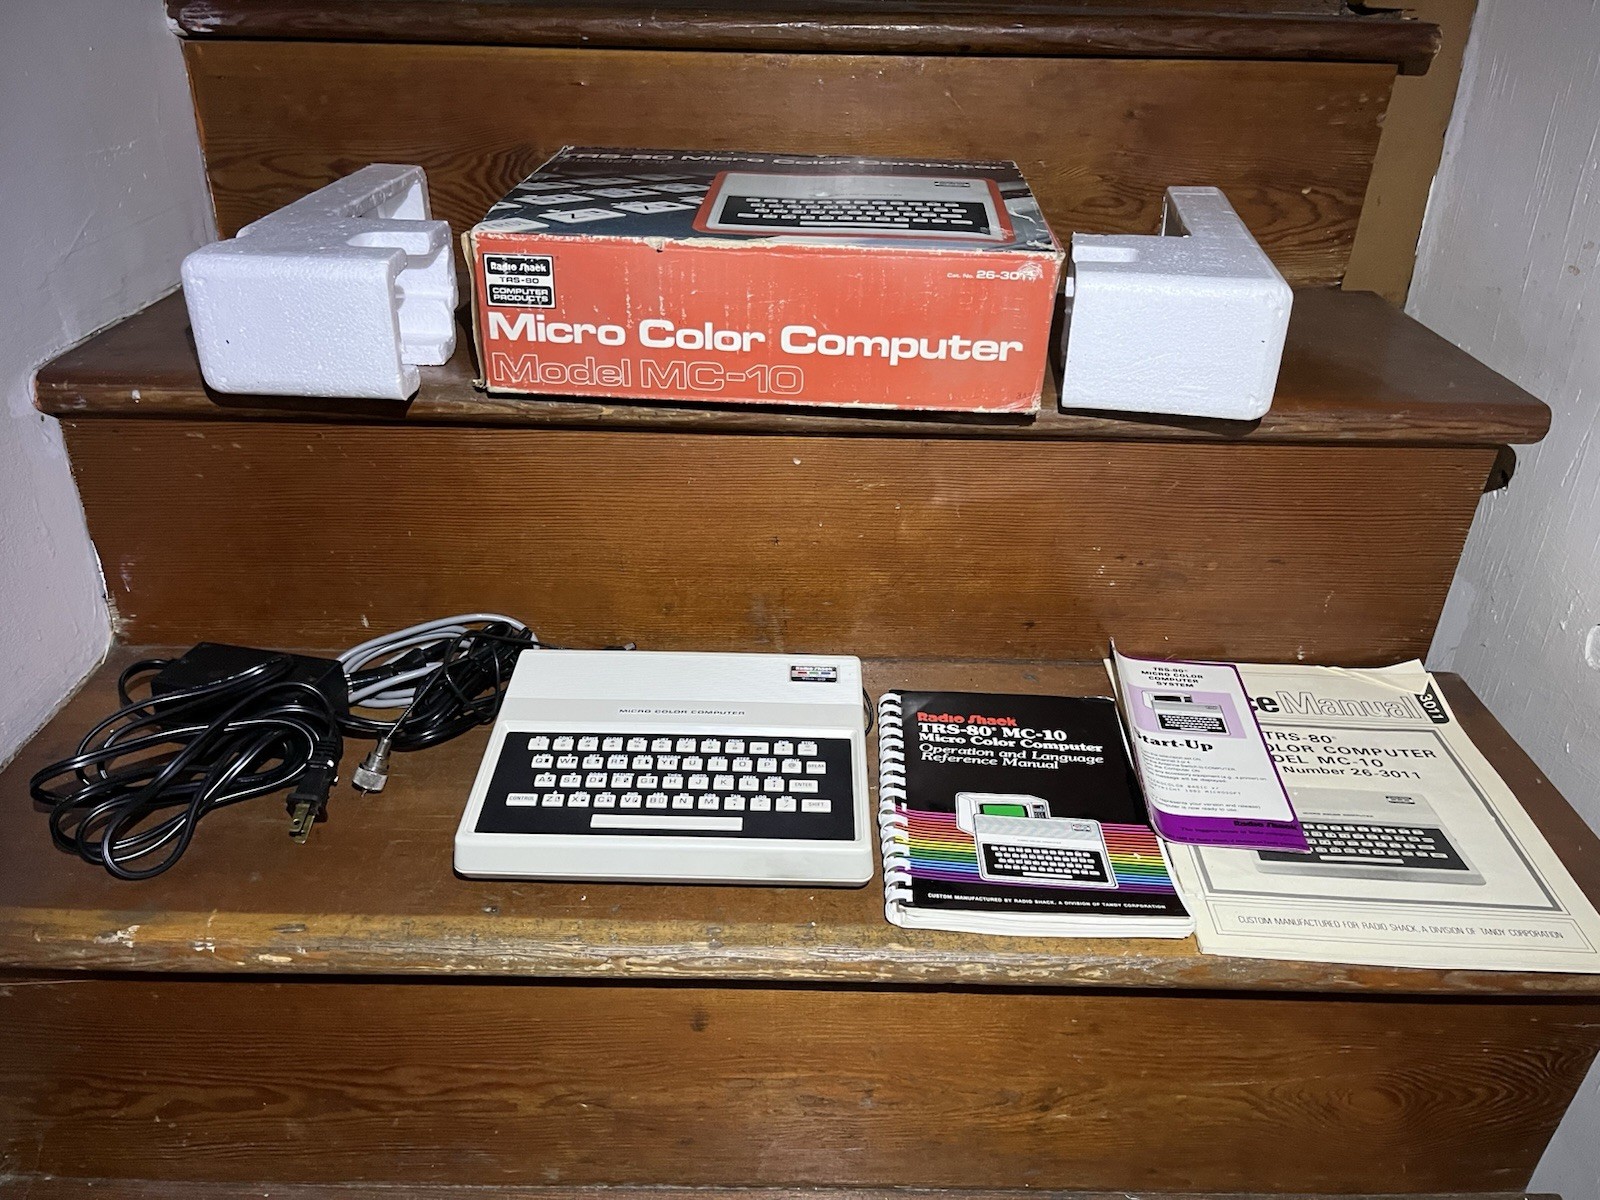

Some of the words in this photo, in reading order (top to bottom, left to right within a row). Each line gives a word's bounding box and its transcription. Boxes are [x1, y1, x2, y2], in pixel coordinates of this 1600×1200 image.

[681, 155, 764, 163] Micro
[490, 261, 517, 272] Radio
[519, 262, 547, 274] Shack
[499, 276, 540, 284] TRS-80
[492, 287, 549, 296] COMPUTER
[493, 294, 549, 303] PRODUCTS
[487, 311, 626, 346] Micro
[639, 319, 766, 352] Color
[781, 325, 1024, 366] Computer
[492, 352, 631, 387] Model
[640, 359, 804, 395] MC-10
[1420, 693, 1444, 718] 3011
[917, 711, 965, 723] Radio
[967, 714, 1018, 726] Shack
[1001, 727, 1067, 741] MC-10
[1263, 731, 1333, 743] TRS-80
[919, 732, 966, 744] Micro
[970, 736, 1016, 747] Color
[1020, 739, 1103, 752] Computer
[919, 743, 994, 757] Operation
[999, 750, 1027, 759] and
[1032, 750, 1104, 765] Language
[1323, 746, 1437, 758] COMPUTER
[921, 752, 998, 766] Reference
[1002, 757, 1059, 769] Manual
[1318, 756, 1384, 768] MC-10
[1283, 766, 1345, 775] Number
[1350, 768, 1422, 780] 26-3011
[1233, 820, 1264, 828] Radio
[927, 892, 953, 900] CUSTOM
[954, 895, 1003, 903] MANUFACTURED
[1238, 915, 1273, 925] CUSTOM
[1274, 917, 1341, 928] MANUFACTURED
[1342, 921, 1360, 929] FOR
[1362, 921, 1388, 931] RADIO
[1421, 925, 1429, 933] A
[1429, 925, 1465, 934] DIVISION
[1465, 927, 1477, 935] OF
[1480, 927, 1506, 936] TANDY
[1508, 929, 1564, 939] CORPORATION
